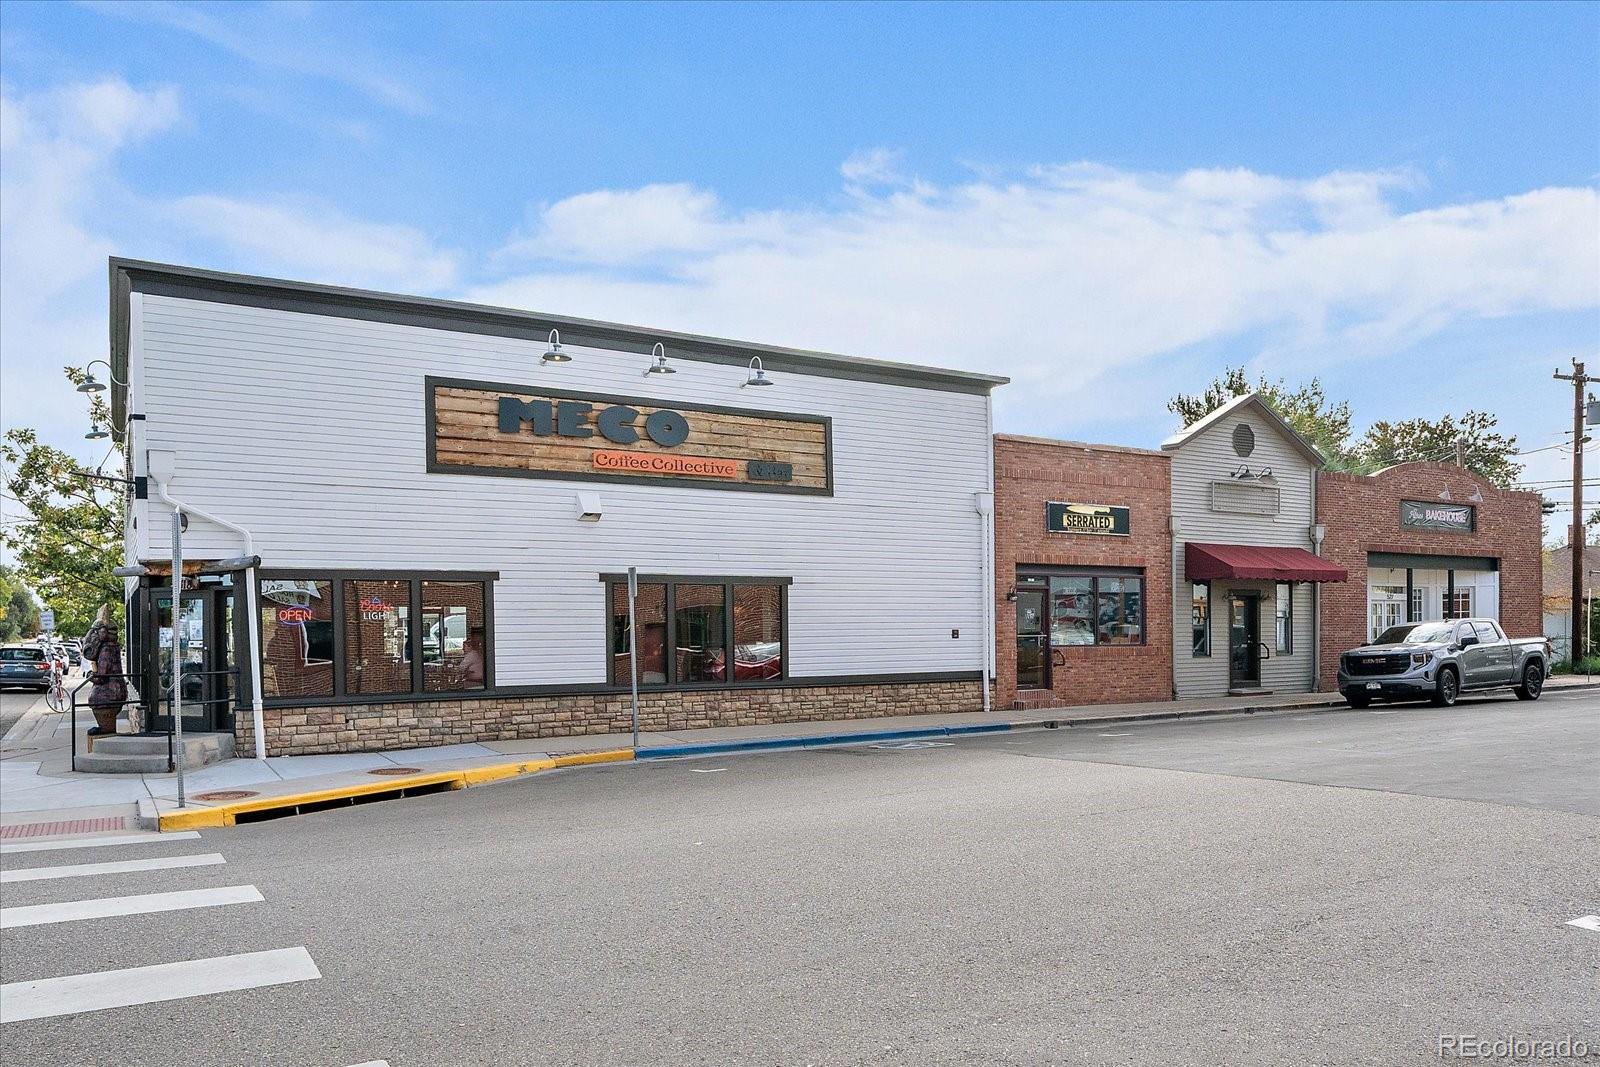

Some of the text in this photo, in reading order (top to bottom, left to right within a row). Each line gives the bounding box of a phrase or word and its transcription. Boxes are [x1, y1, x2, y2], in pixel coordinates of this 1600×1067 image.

[498, 396, 690, 447] MECO
[595, 453, 734, 475] Coffee Collective
[1066, 514, 1111, 529] SERRATED
[1425, 509, 1467, 523] BAKEHOUSE
[279, 610, 312, 621] OPEN
[363, 612, 391, 620] LIGHT
